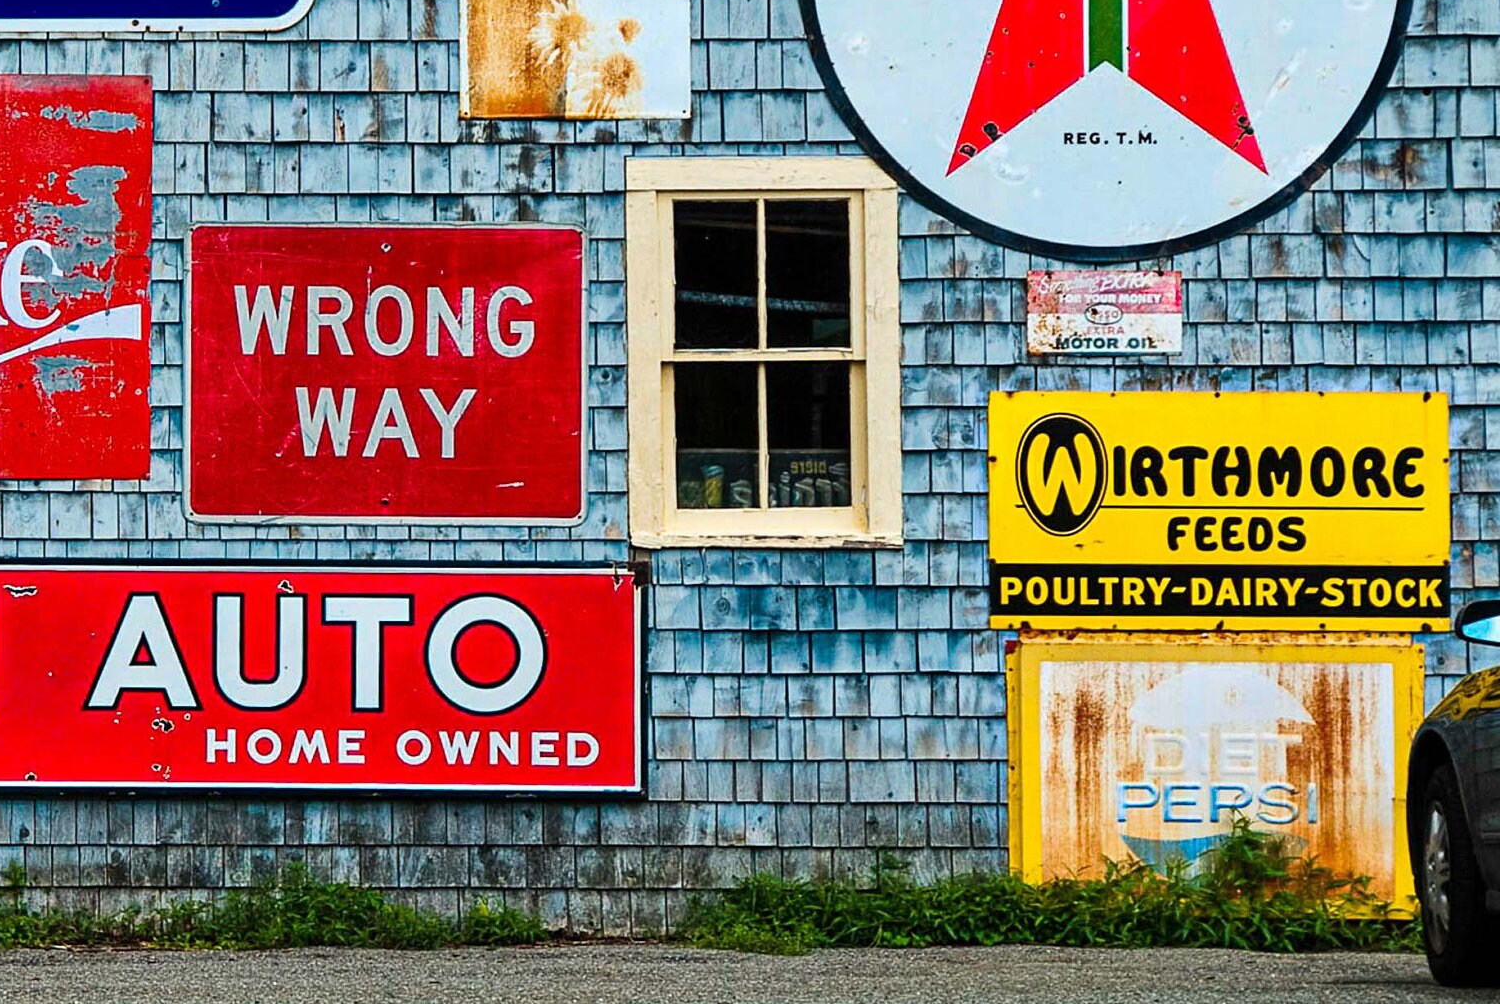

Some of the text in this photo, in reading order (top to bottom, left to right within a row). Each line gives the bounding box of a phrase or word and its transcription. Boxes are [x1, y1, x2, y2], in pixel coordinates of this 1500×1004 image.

[1063, 132, 1109, 147] REG.
[1059, 293, 1162, 304] FOR YOUR MONEY
[234, 284, 536, 358] WRONG
[1086, 325, 1125, 335] EXTRA
[1056, 336, 1158, 350] MOTOR OIL
[295, 387, 477, 459] WAY
[1025, 432, 1425, 517] WIRTHMORE
[1167, 516, 1307, 553] FEEDS
[85, 592, 548, 715] AUTO
[205, 728, 601, 767] HOME OWNED
[1146, 732, 1303, 778] DIET
[1116, 782, 1319, 825] PEPSI
